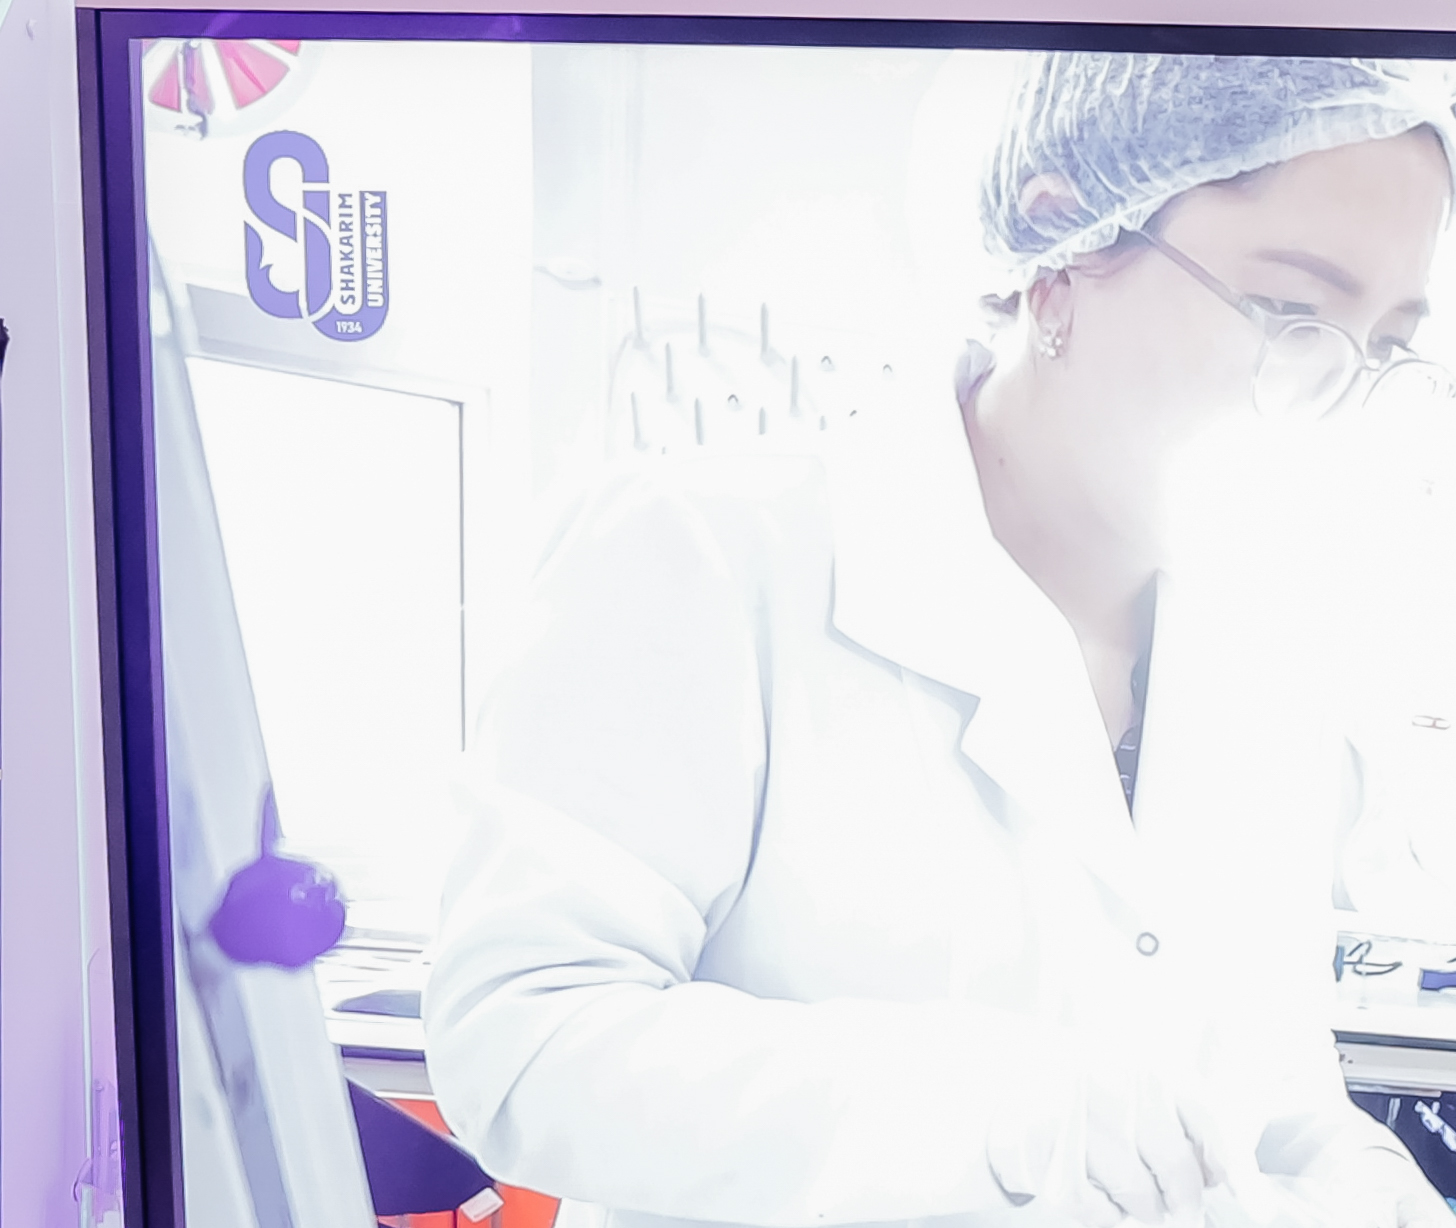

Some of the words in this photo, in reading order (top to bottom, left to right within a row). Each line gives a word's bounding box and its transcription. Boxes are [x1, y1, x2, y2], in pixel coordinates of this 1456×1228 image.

[339, 193, 356, 305] SHAKARIM
[365, 192, 386, 308] UNIVERSITY
[335, 319, 363, 334] 1934
